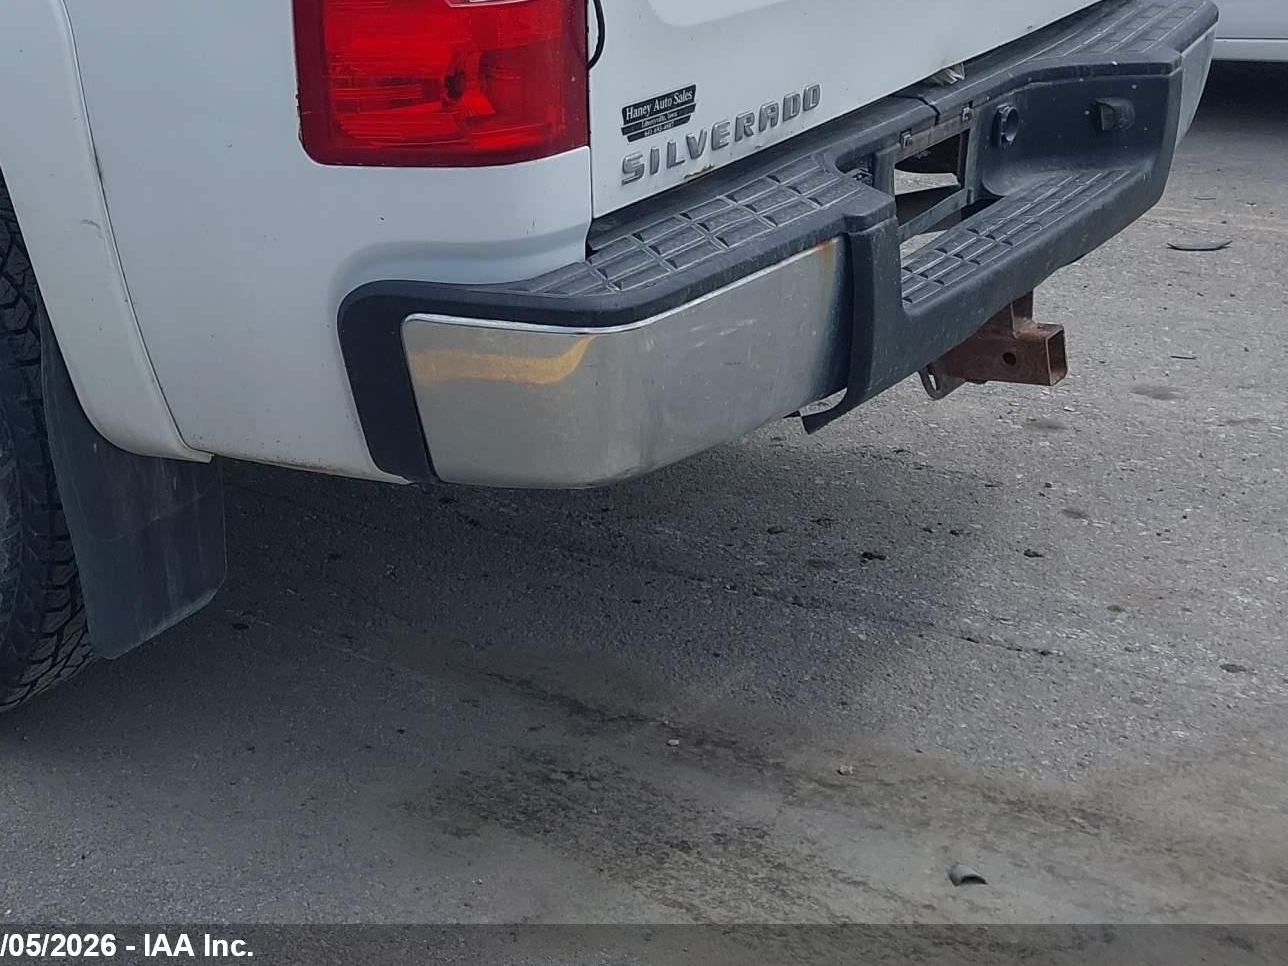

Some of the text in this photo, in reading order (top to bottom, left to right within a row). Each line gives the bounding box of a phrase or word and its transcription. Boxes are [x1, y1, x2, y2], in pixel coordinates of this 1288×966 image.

[621, 84, 821, 185] SILVERADO
[625, 89, 693, 121] Haney Auto Sales
